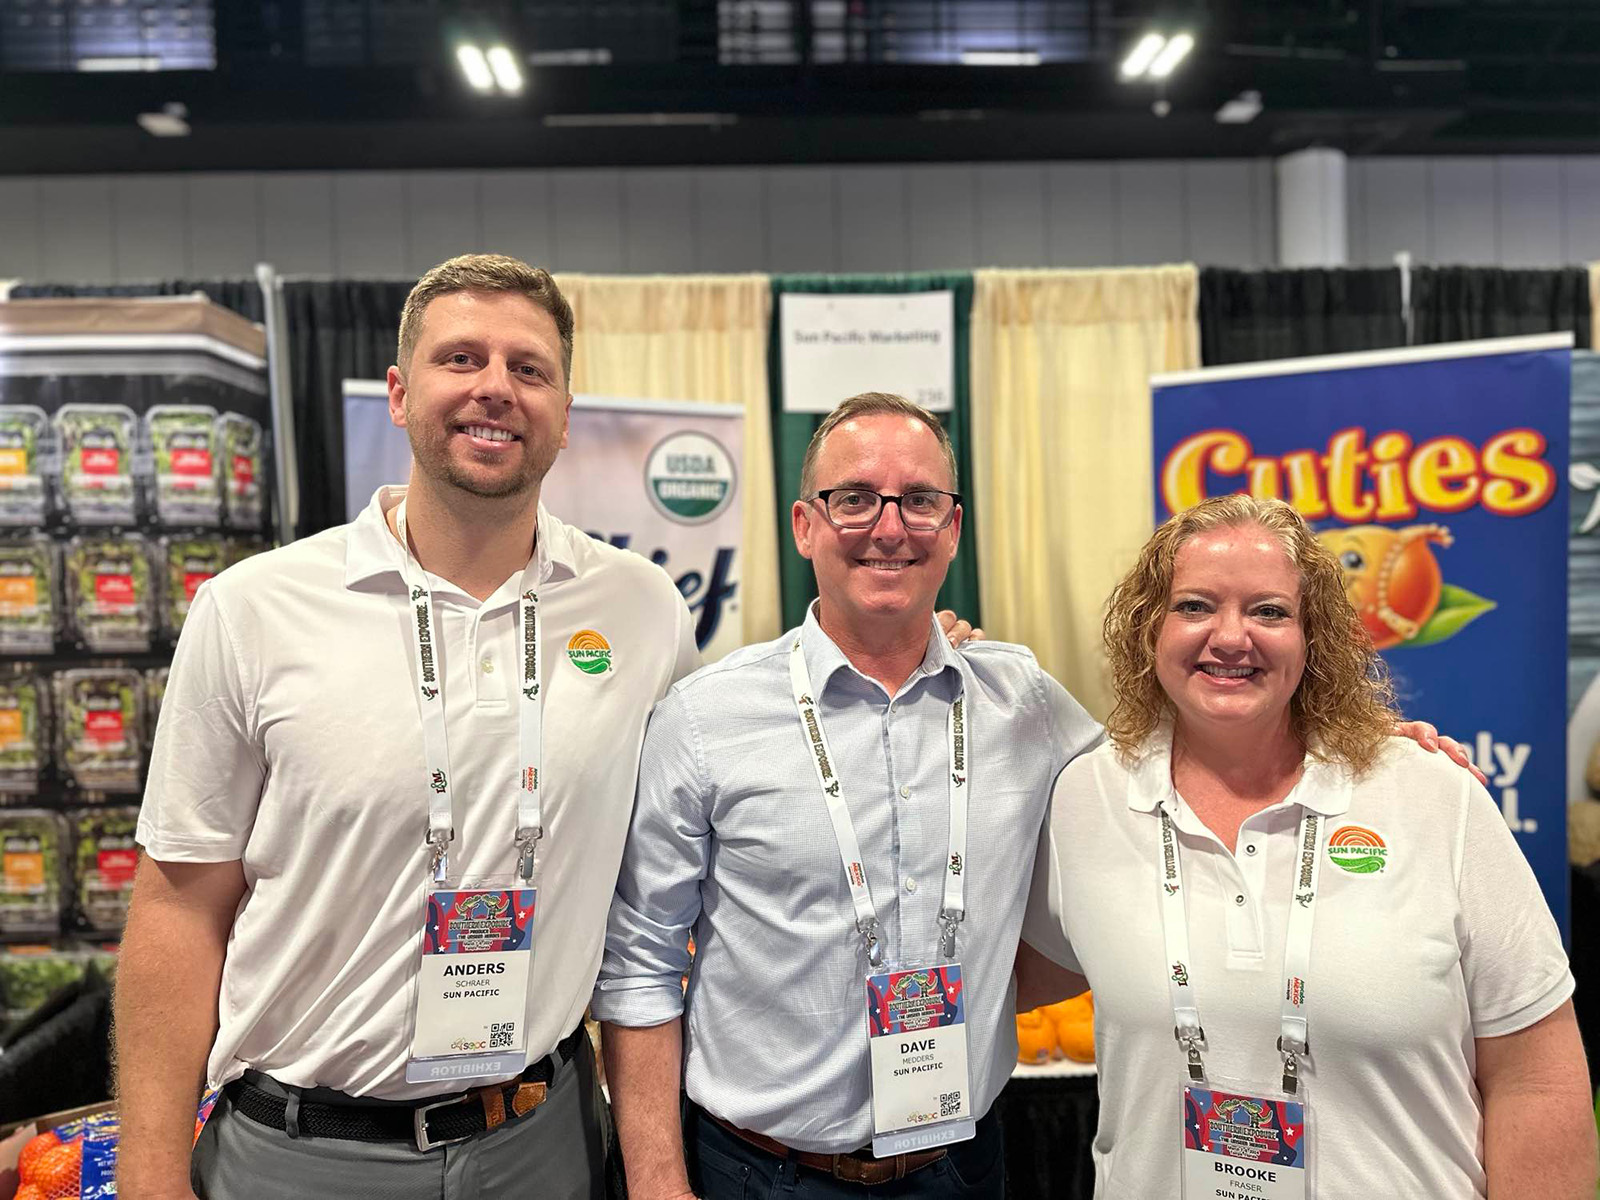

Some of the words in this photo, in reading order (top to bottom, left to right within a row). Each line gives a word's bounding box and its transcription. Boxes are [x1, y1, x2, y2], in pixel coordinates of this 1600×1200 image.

[794, 329, 818, 343] Sun
[822, 329, 866, 345] Pacific
[869, 329, 941, 345] Marketing
[666, 454, 716, 473] USDA
[1161, 426, 1557, 523] Cuties
[659, 481, 722, 499] ORGANIC
[568, 650, 585, 658] SUN
[586, 650, 612, 658] PACIFIC
[1328, 847, 1348, 855] SUN
[1350, 847, 1388, 856] PACIFIC
[443, 963, 505, 976] ANDERS
[455, 979, 490, 988] SCHRAER
[443, 991, 461, 999] SUN
[464, 989, 500, 998] PACIFIC
[900, 1038, 935, 1054] DAVE
[902, 1054, 934, 1064] MEDDERS
[893, 1068, 909, 1077] SUN
[911, 1062, 943, 1073] PACIFIC
[1215, 1162, 1276, 1182] BROOKE
[1230, 1180, 1262, 1193] FRASER
[1216, 1189, 1235, 1199] SUN
